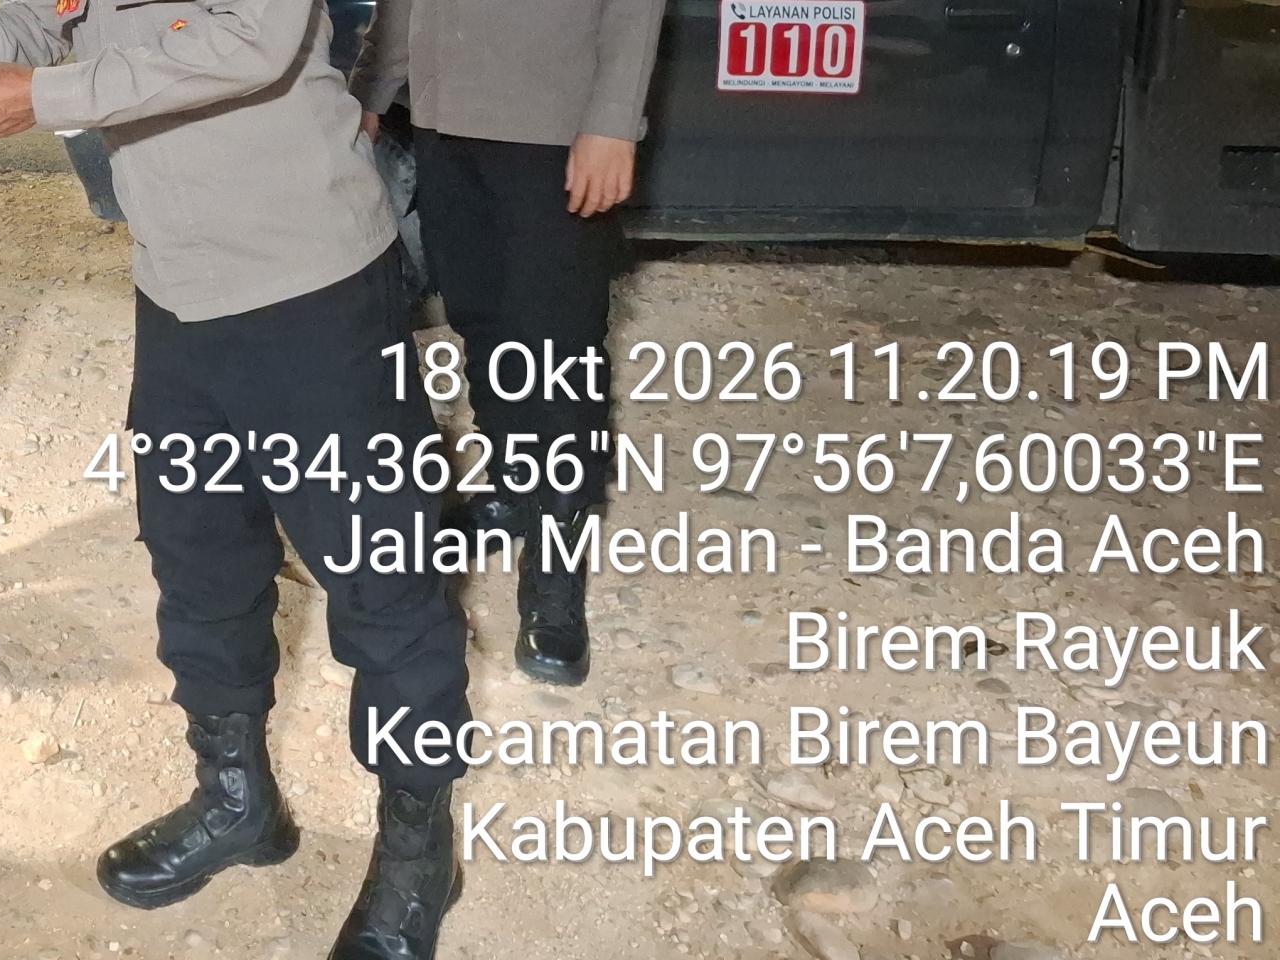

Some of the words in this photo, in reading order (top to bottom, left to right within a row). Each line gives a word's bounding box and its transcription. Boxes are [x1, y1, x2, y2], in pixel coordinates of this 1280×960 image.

[749, 5, 809, 19] LAYANAN
[813, 6, 856, 20] POLISI
[739, 24, 847, 76] 110
[722, 79, 766, 87] MELINDUNGI
[771, 80, 814, 88] MENGAYOMI
[819, 81, 854, 89] MELAYANI
